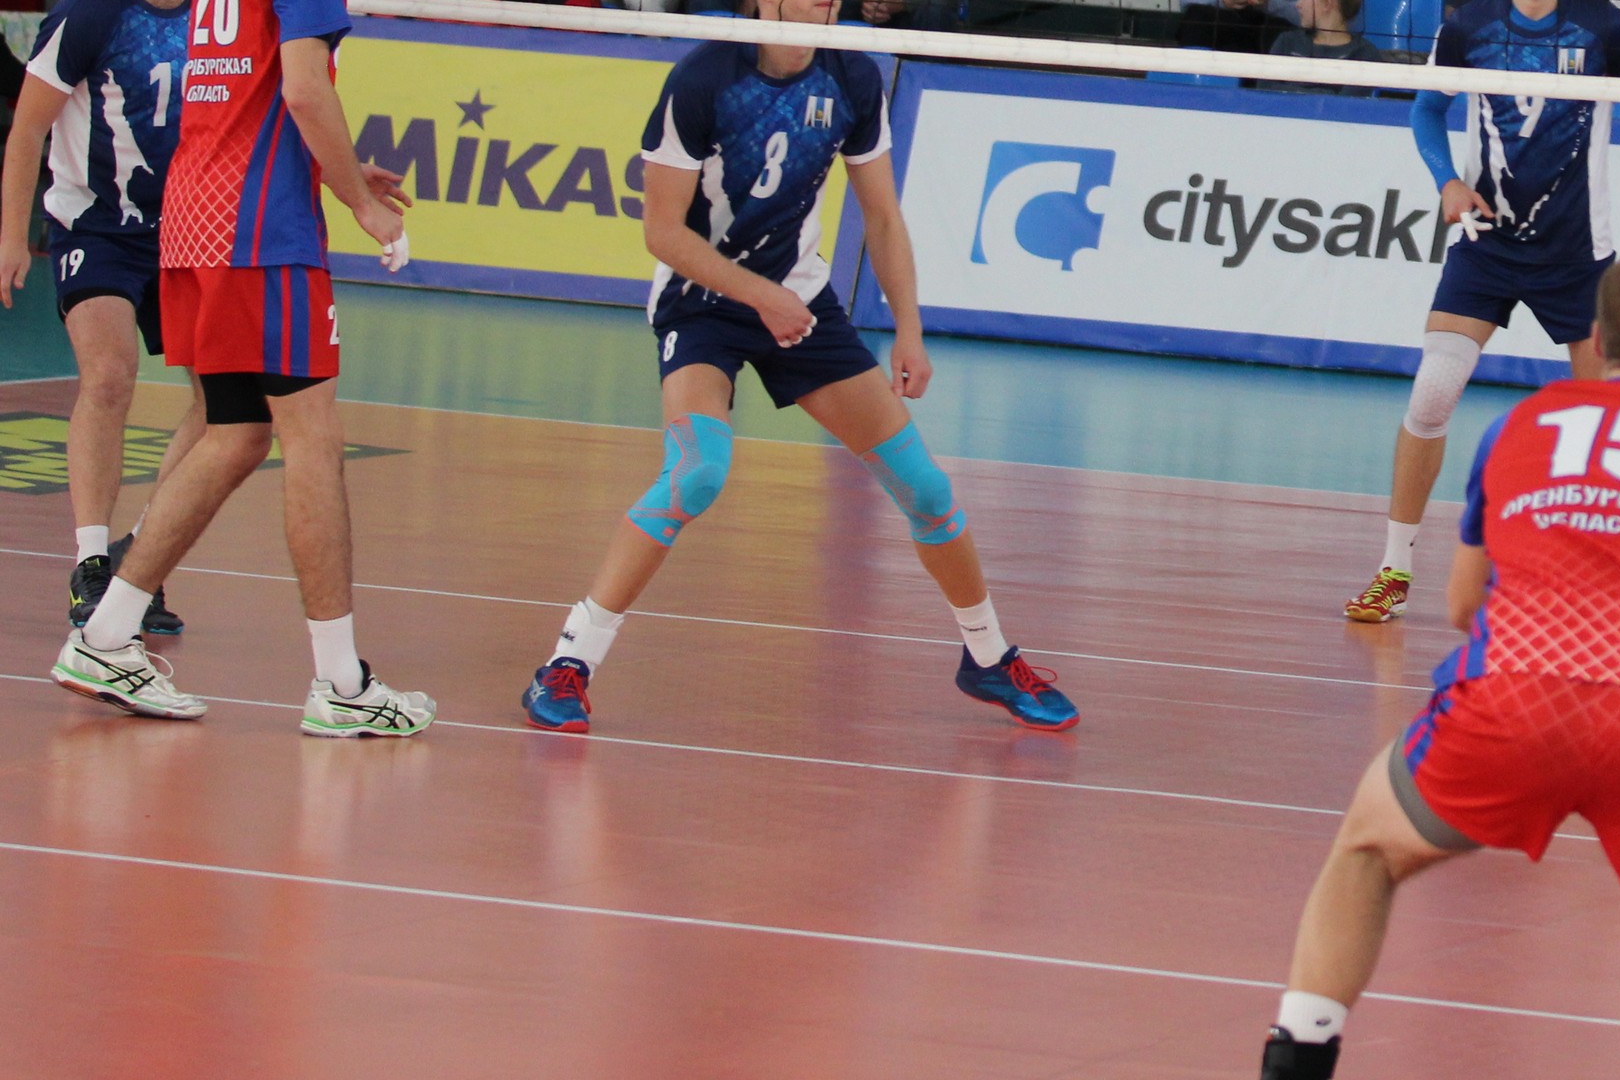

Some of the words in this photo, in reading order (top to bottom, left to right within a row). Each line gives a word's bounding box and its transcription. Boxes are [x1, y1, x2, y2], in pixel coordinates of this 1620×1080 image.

[749, 131, 789, 199] 8
[60, 248, 85, 282] 19
[663, 330, 678, 362] 8
